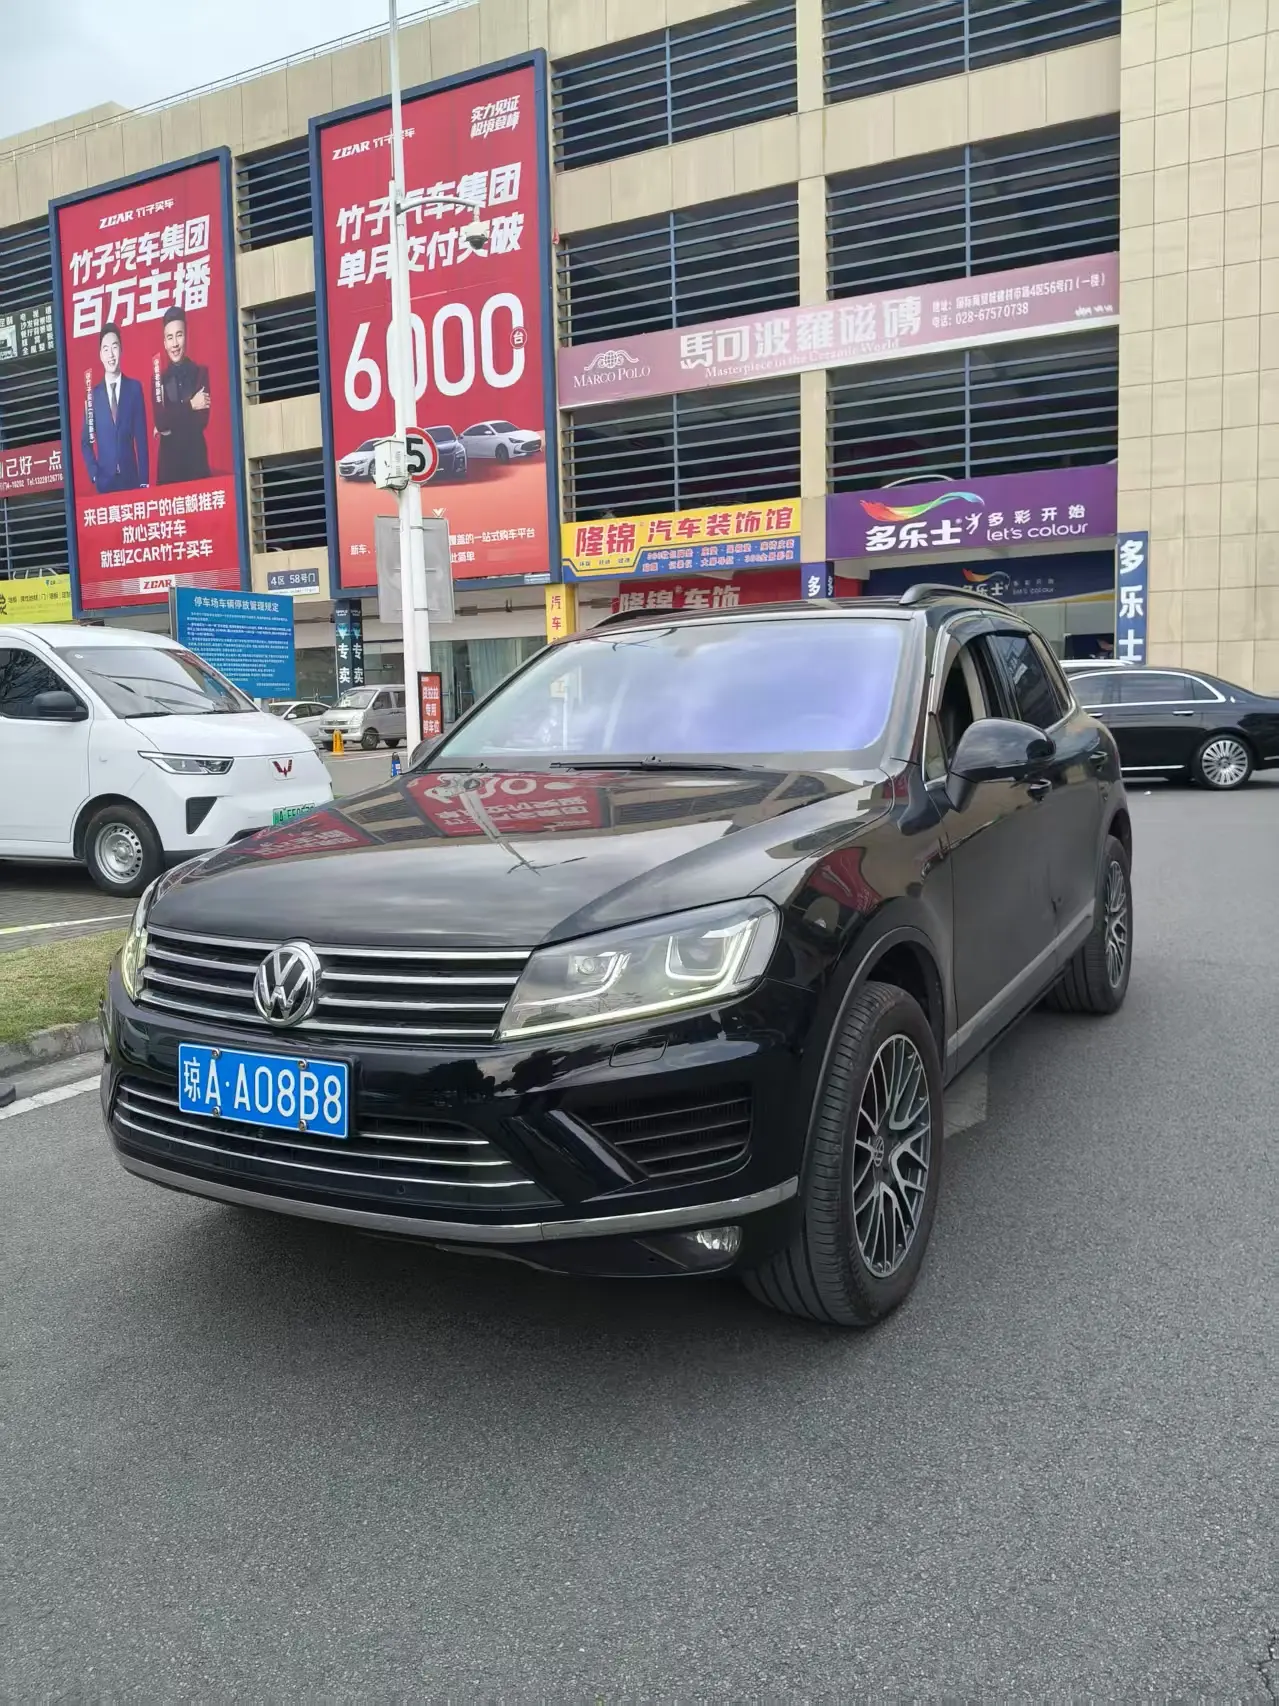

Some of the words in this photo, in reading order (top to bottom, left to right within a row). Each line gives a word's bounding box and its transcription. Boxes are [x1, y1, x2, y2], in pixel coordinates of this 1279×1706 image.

[332, 141, 371, 160] ZCAR
[99, 210, 134, 230] ZCAR
[69, 214, 210, 286] 竹子汽车集团
[72, 255, 211, 339] 百万主播
[344, 292, 526, 411] 6000
[704, 357, 773, 379] Masterpiece
[774, 357, 787, 367] in
[859, 339, 900, 353] World
[573, 370, 616, 388] MARCO
[617, 367, 651, 381] POLO
[84, 490, 226, 527] 来自真实用户的信赖推荐
[648, 507, 793, 543] 汽车装饰馆
[987, 504, 1086, 527] 多彩开始
[122, 519, 187, 545] 放心买好车
[576, 522, 636, 558] 隆锦
[865, 519, 963, 551] 多乐士
[1027, 521, 1089, 538] colour
[100, 539, 214, 568] 就到ZCAR竹子买车
[143, 579, 172, 590] ZCAR
[270, 576, 285, 585] 4区
[289, 573, 316, 584] 58号门
[808, 576, 821, 597] 多
[1118, 539, 1145, 662] 多乐士
[337, 642, 351, 684] 专卖
[352, 642, 363, 684] 专卖
[183, 1056, 342, 1125] 琼A·A08B8
